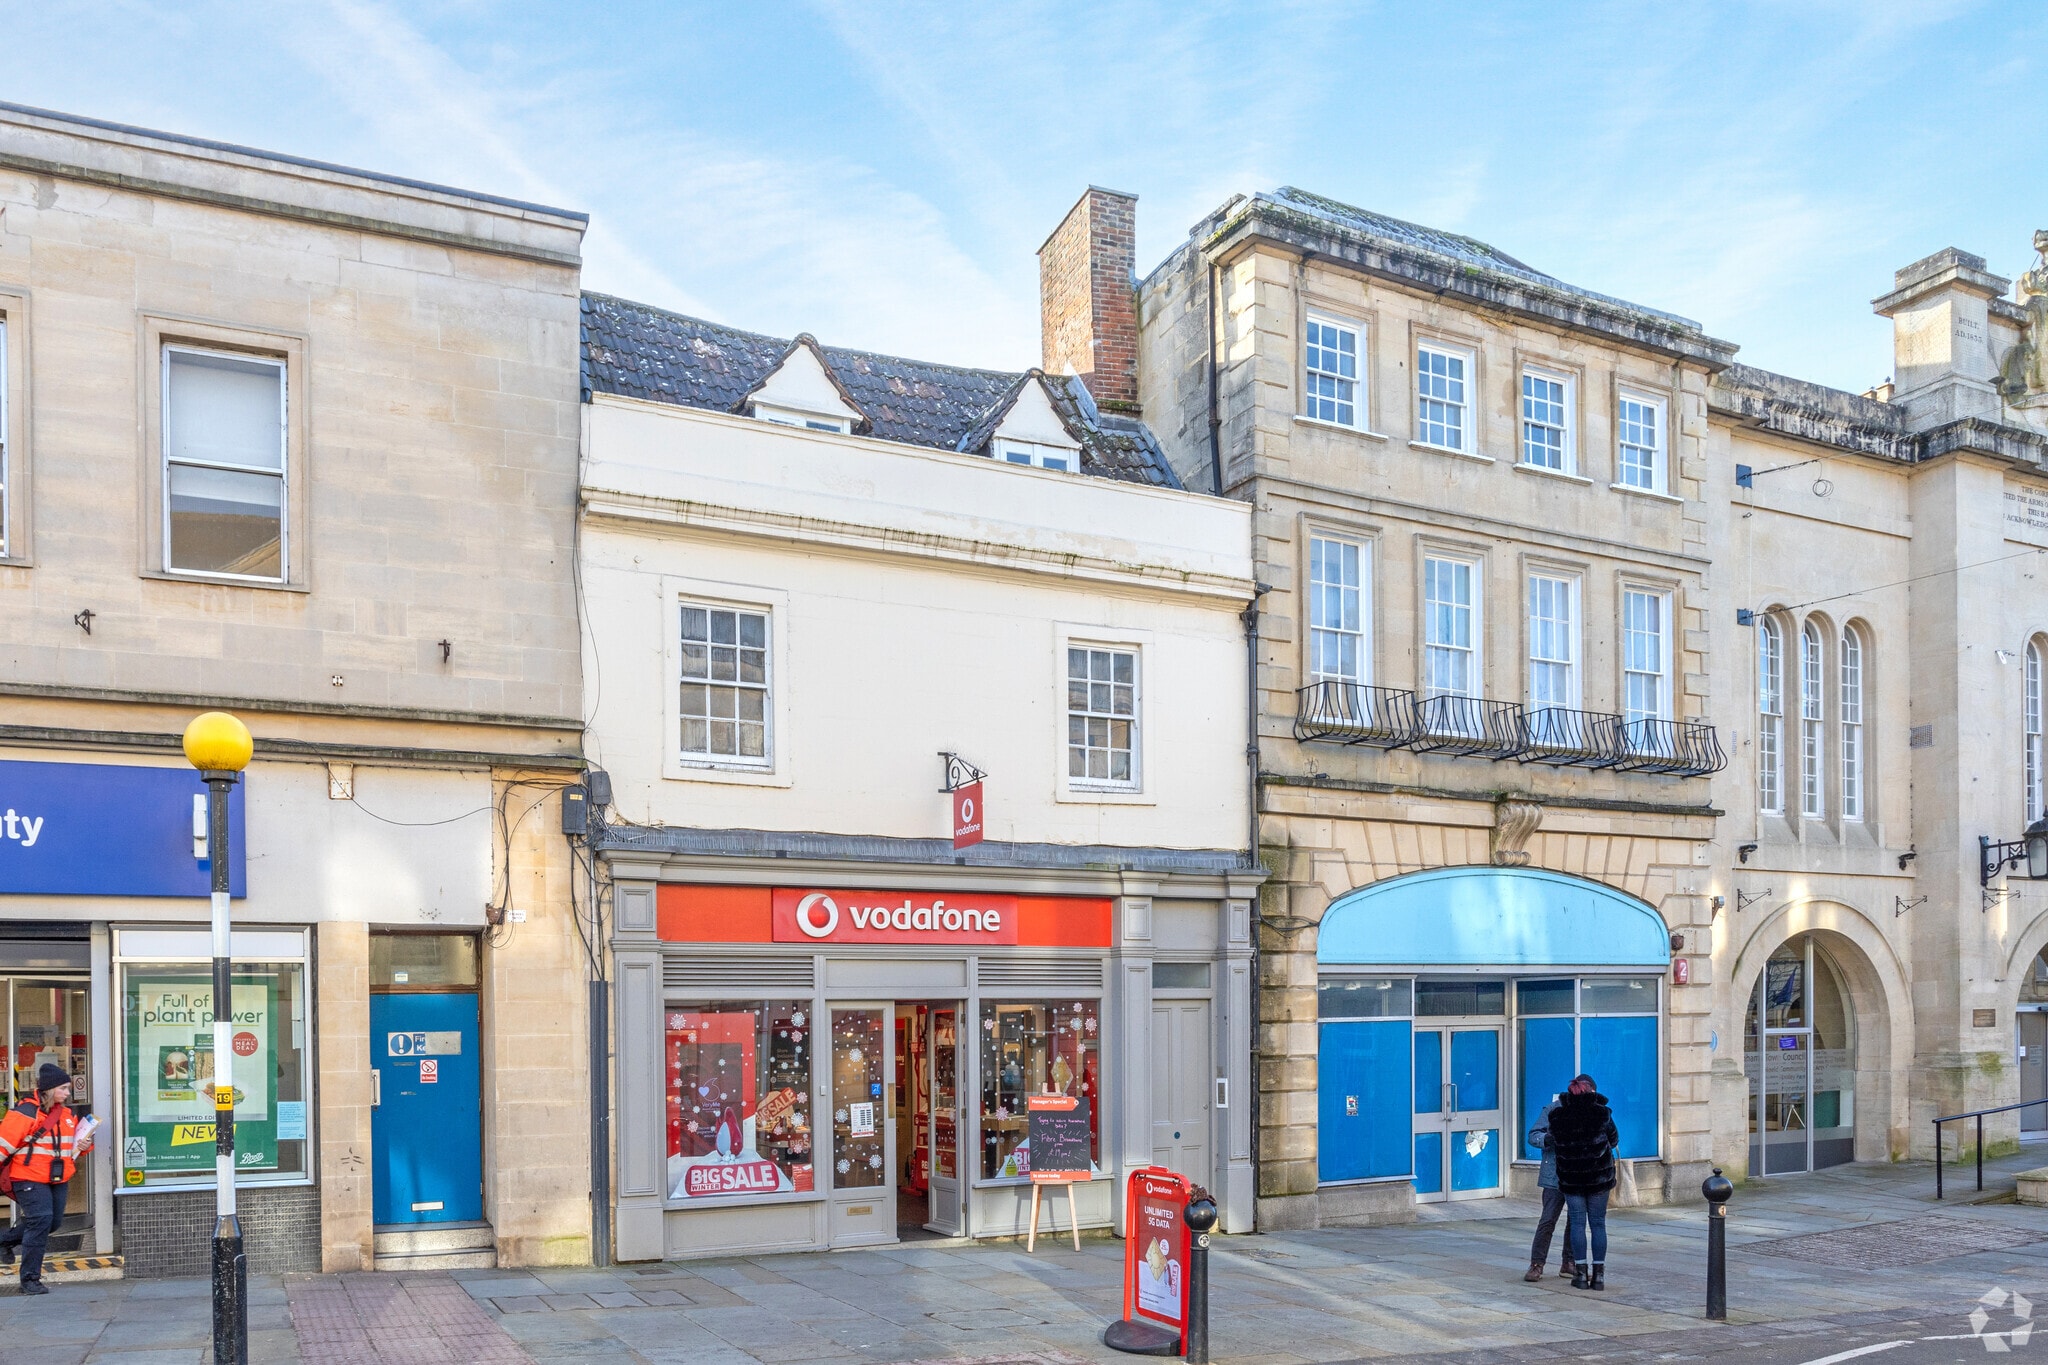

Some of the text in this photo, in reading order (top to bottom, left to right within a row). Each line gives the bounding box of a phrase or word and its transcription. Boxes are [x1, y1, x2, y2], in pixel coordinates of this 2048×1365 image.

[2028, 498, 2044, 508] ARMS
[955, 822, 981, 837] vodafone
[849, 900, 1001, 932] vodafone
[1680, 962, 1687, 976] 2
[162, 994, 209, 1008] Full of
[144, 1006, 263, 1027] plant pwer
[217, 1094, 230, 1103] 19
[691, 1168, 720, 1184] BIG
[722, 1165, 775, 1190] SALE
[691, 1184, 720, 1192] WINTER
[1153, 1185, 1173, 1195] vodafone
[1144, 1205, 1173, 1219] UNLIMITED
[1148, 1216, 1170, 1229] 5G DATA
